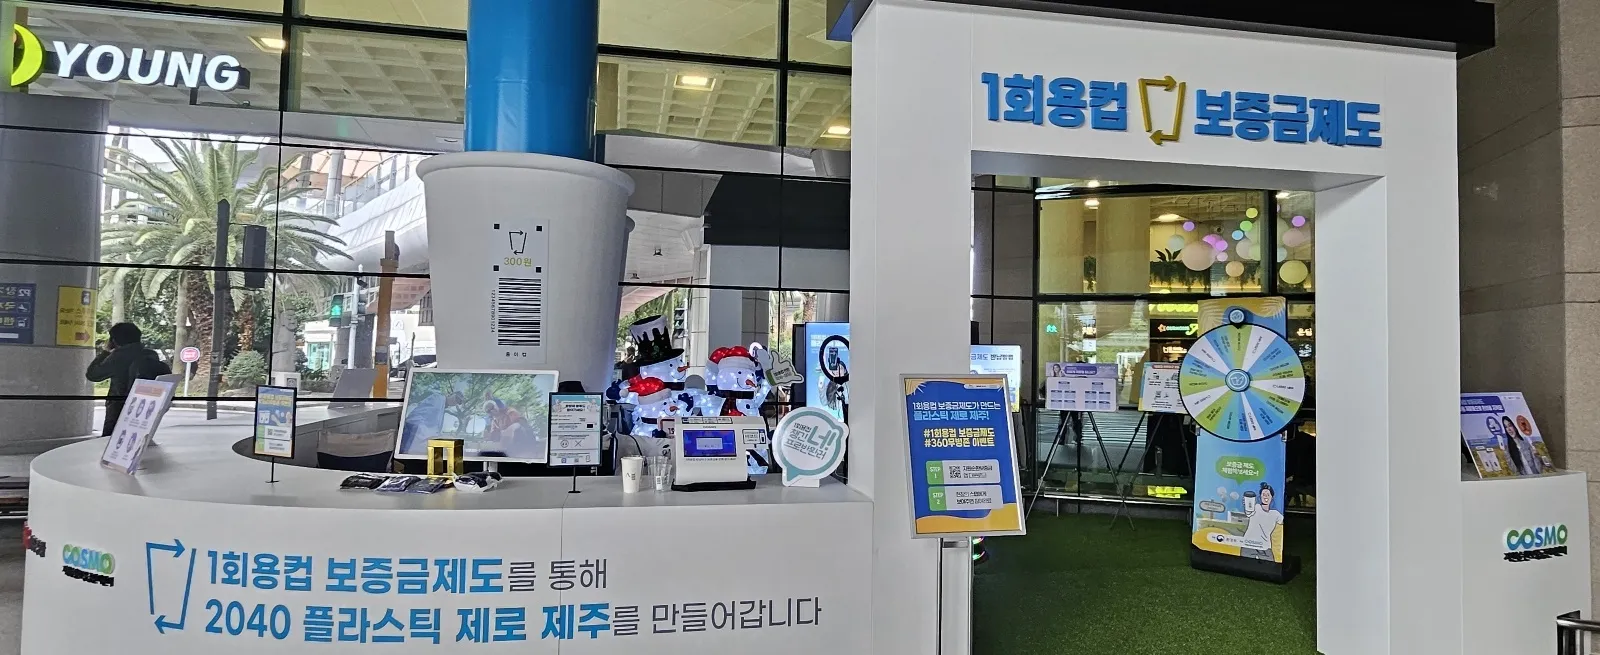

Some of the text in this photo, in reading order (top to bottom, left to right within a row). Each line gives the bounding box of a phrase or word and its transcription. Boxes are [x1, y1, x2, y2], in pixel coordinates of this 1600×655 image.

[52, 40, 242, 92] YOUNG
[981, 71, 1383, 148] 1회용컵 보증금제도
[503, 257, 532, 267] 300원
[913, 402, 1001, 411] 1회용컵 보증금제도가 만드는
[913, 411, 990, 421] 플라스틱 제로 제주!
[923, 428, 996, 438] #1회용컵 보증금제도
[972, 438, 996, 448] 이벤트
[1506, 524, 1568, 550] COSMO
[62, 543, 116, 575] COSMO
[207, 550, 608, 596] 1회용컵 보증금제도를 통해
[205, 596, 823, 645] 2040 플라스틱 제로 제주를 만들어갑니다
